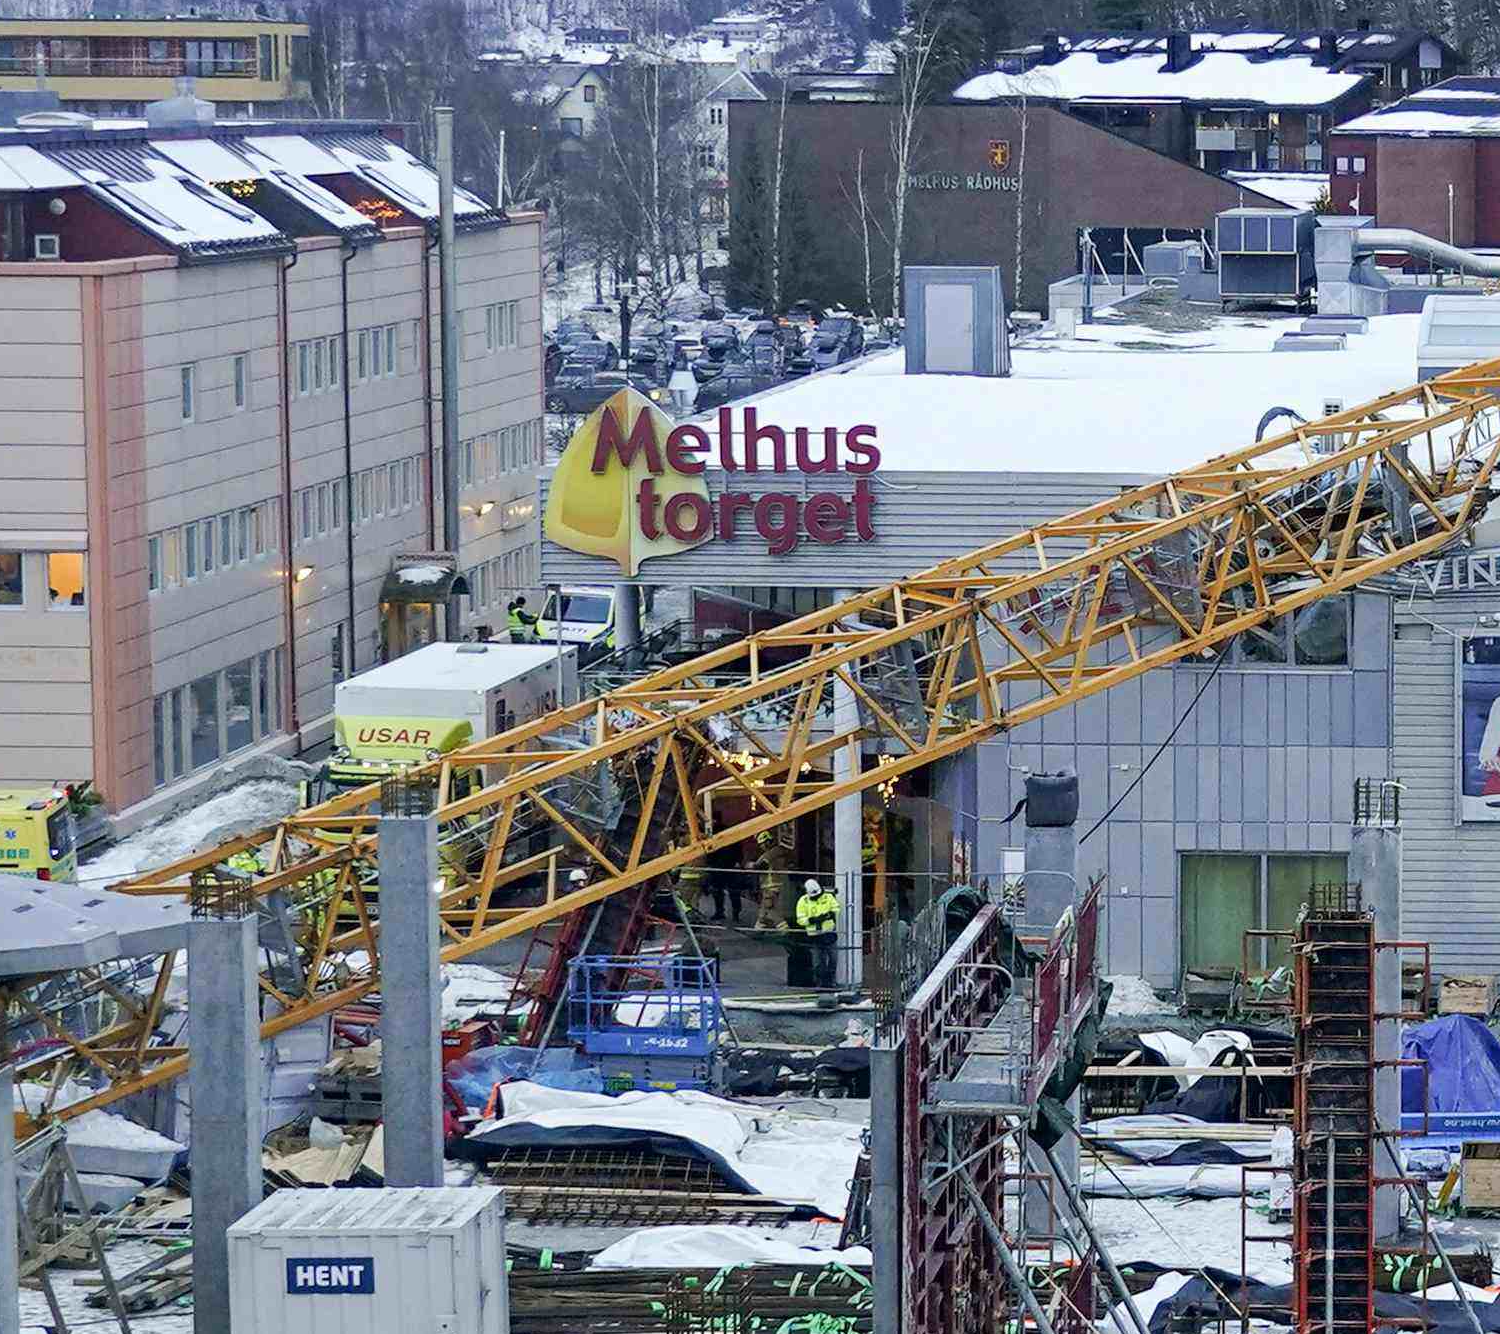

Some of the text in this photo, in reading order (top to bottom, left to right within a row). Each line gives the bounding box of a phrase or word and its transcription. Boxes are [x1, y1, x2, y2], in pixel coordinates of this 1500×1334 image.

[966, 172, 1020, 191] RÅDHUS
[591, 406, 882, 477] Melhus
[636, 478, 877, 555] torget
[357, 727, 432, 745] USAR
[296, 1265, 365, 1287] HENT
